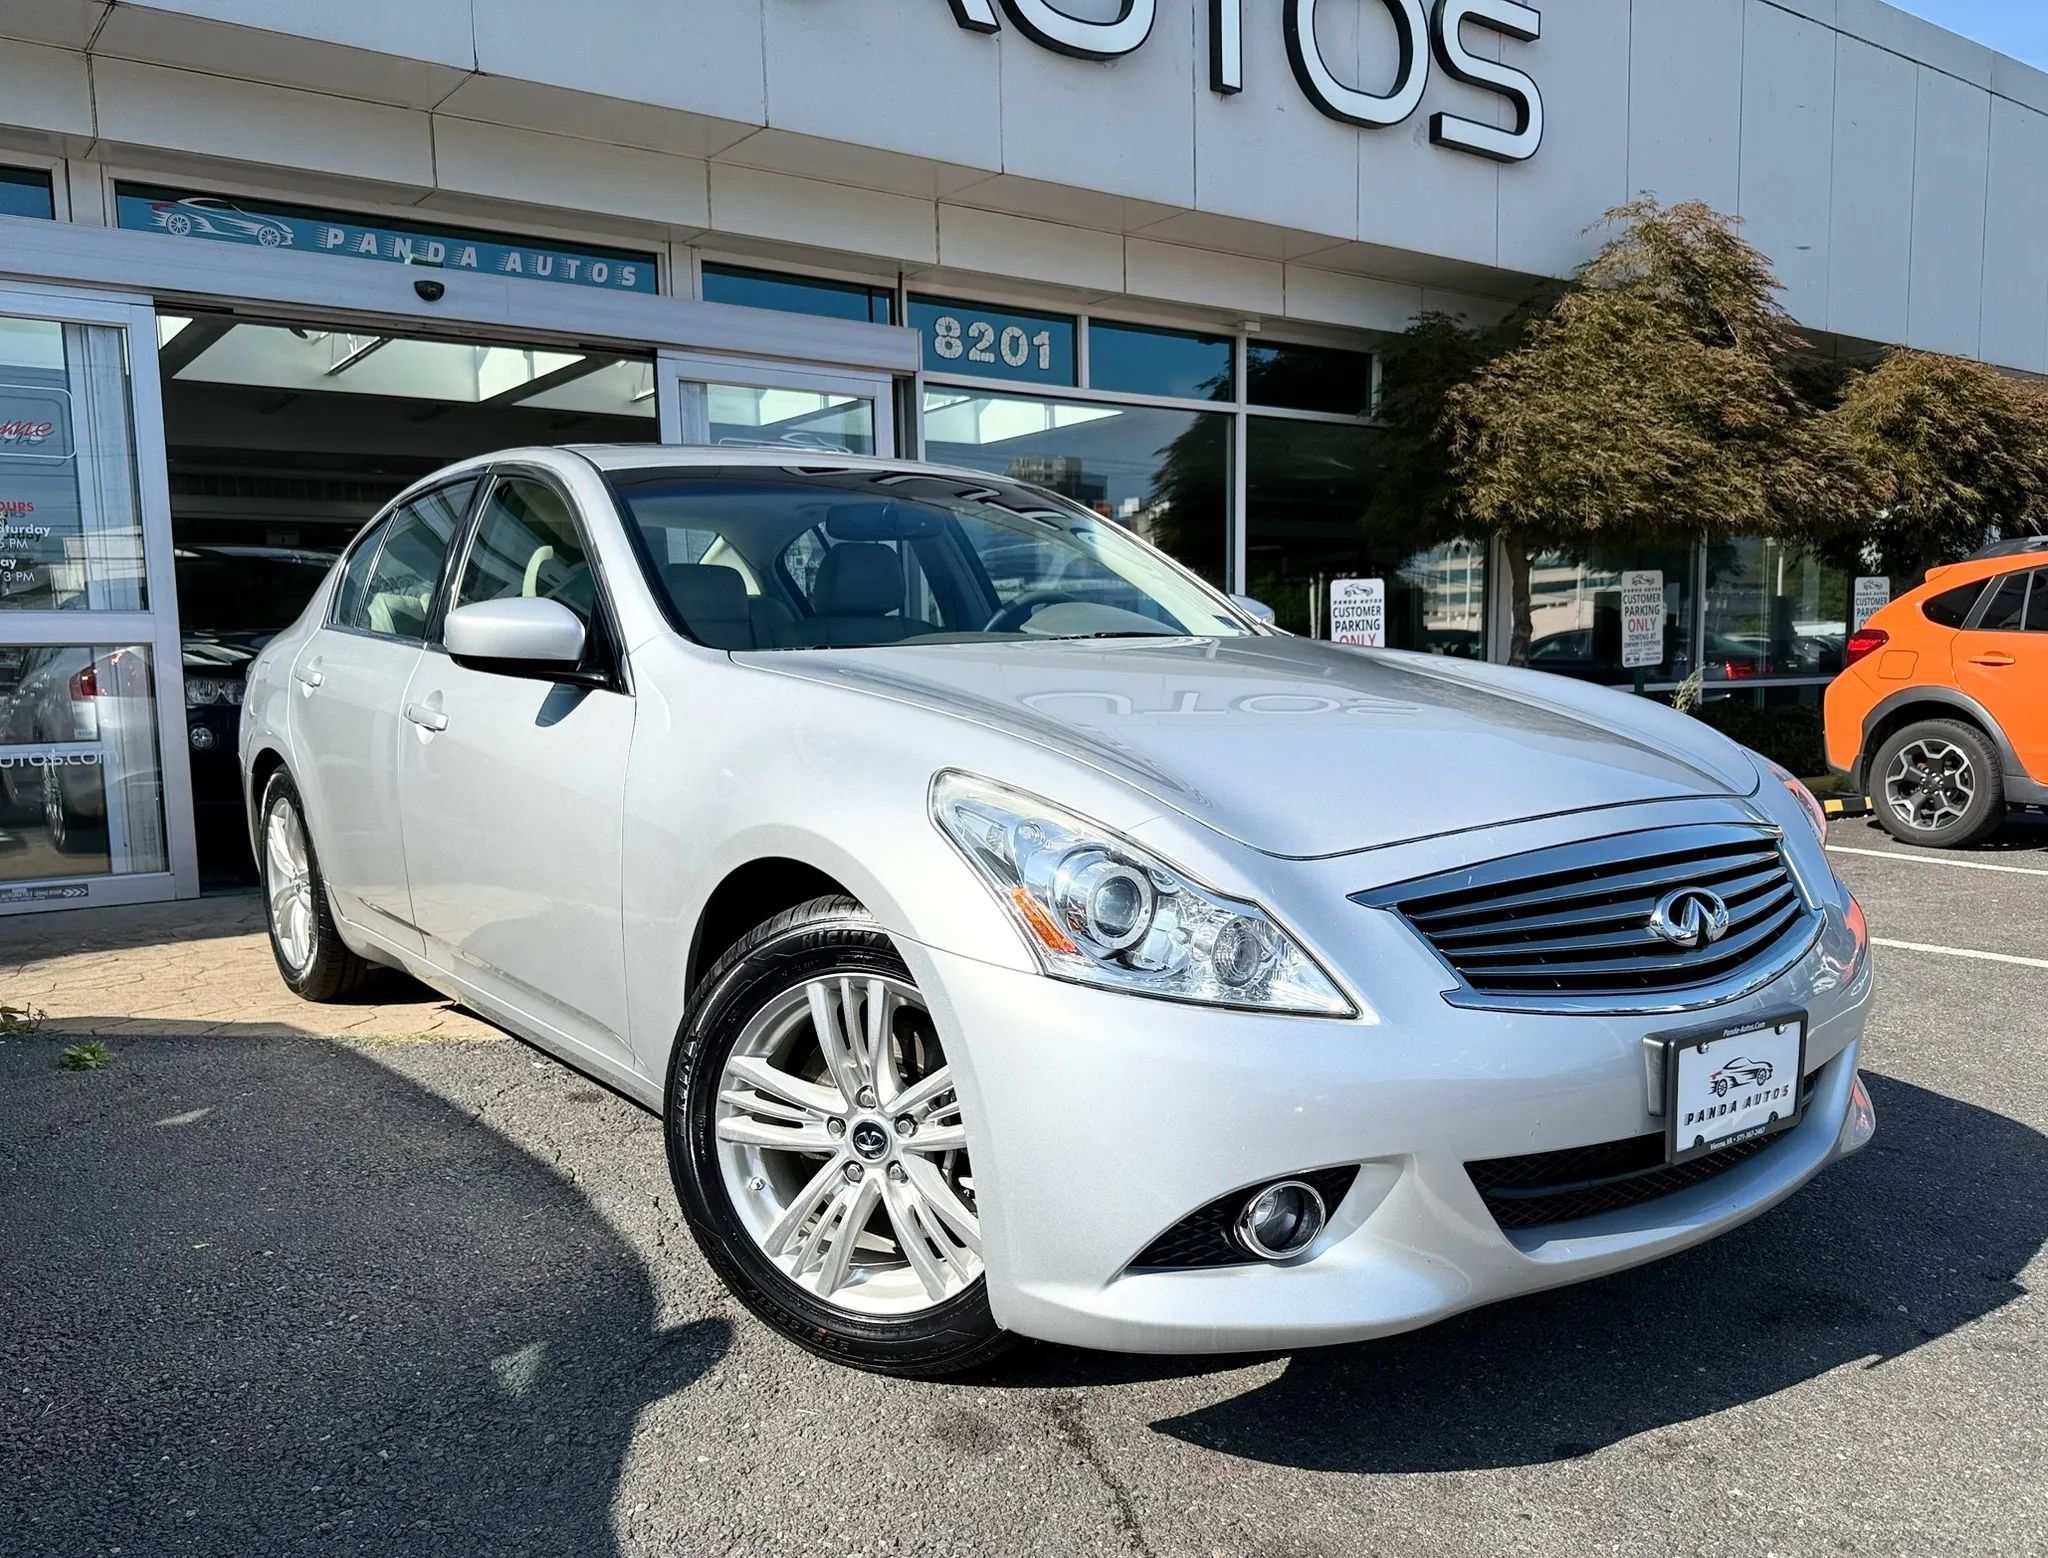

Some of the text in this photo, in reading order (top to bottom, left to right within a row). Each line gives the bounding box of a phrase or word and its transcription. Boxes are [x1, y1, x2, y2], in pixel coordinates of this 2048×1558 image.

[312, 225, 637, 287] PANDA AUTOS
[934, 316, 1050, 370] 8201
[9, 538, 29, 549] PM
[15, 570, 35, 582] PM
[1623, 593, 1661, 604] CUSTOMER
[1333, 606, 1381, 618] CUSTOMER
[1625, 605, 1660, 616] PARKING
[1335, 619, 1380, 632] PARKING
[1628, 618, 1656, 632] ONLY
[1684, 1085, 1789, 1126] PANDA AUTOS
